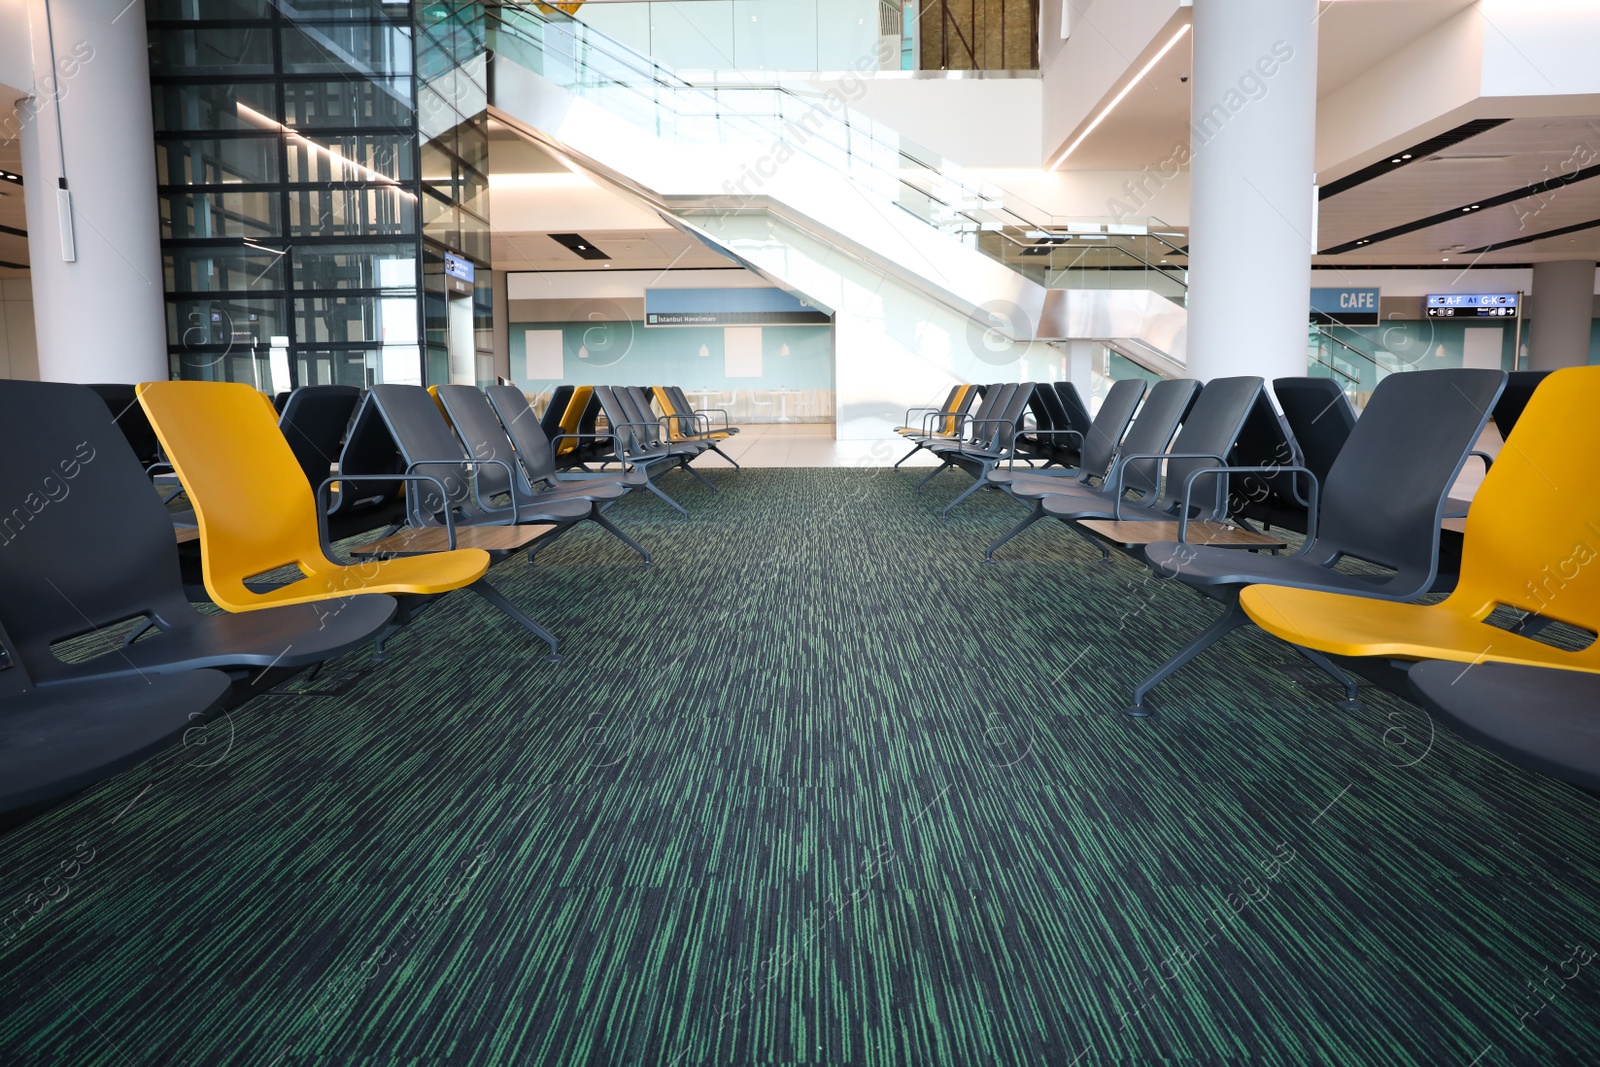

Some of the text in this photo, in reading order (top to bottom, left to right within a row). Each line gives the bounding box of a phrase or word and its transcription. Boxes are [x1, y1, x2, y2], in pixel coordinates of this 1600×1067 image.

[1340, 293, 1374, 308] CAFE
[1446, 296, 1462, 305] A-F
[1481, 296, 1498, 305] G-K
